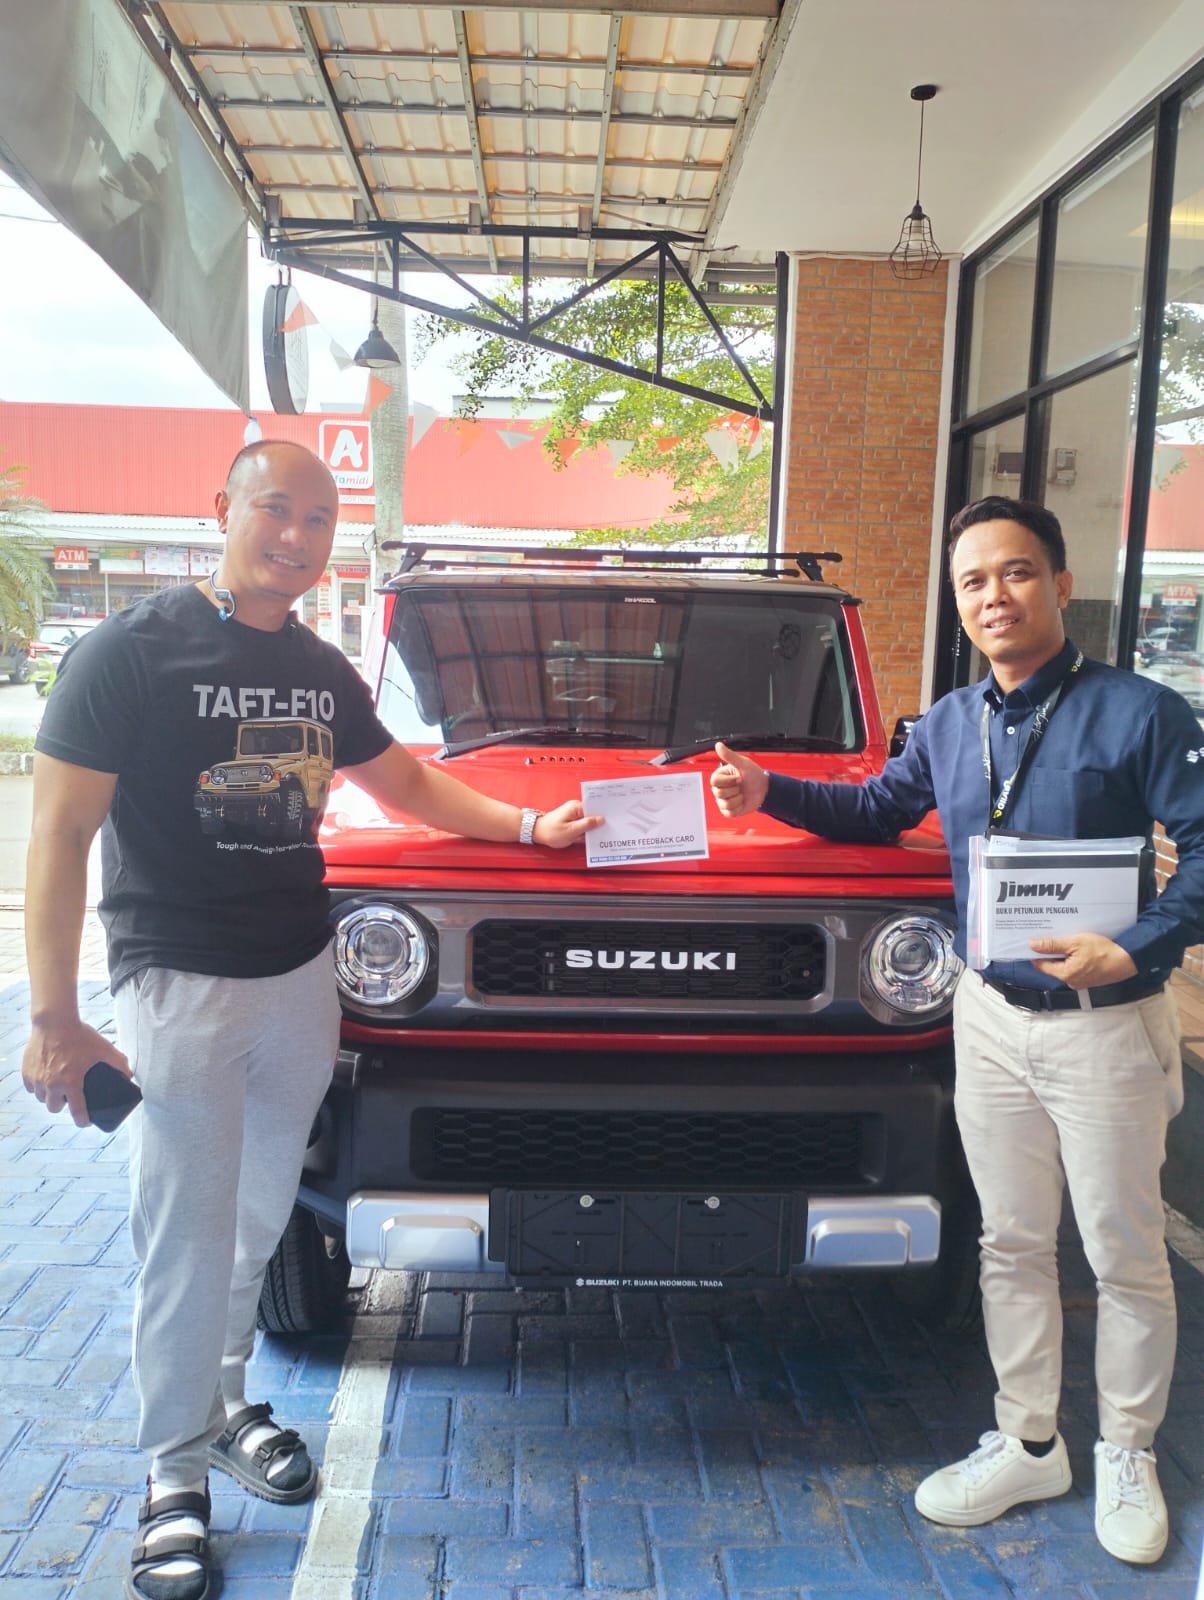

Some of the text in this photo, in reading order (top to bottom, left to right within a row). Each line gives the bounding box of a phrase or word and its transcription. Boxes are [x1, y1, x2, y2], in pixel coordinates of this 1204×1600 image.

[335, 475, 368, 485] famidi
[57, 549, 85, 561] ATM
[193, 684, 335, 721] TAFT-F10
[216, 841, 239, 851] Tough
[599, 839, 636, 849] CUSTOMER
[638, 836, 674, 846] FEEDBACK
[675, 834, 695, 843] CARD
[996, 906, 1079, 915] BUKU PETUNJUK PENGGUNA
[565, 949, 736, 971] SUZUKI
